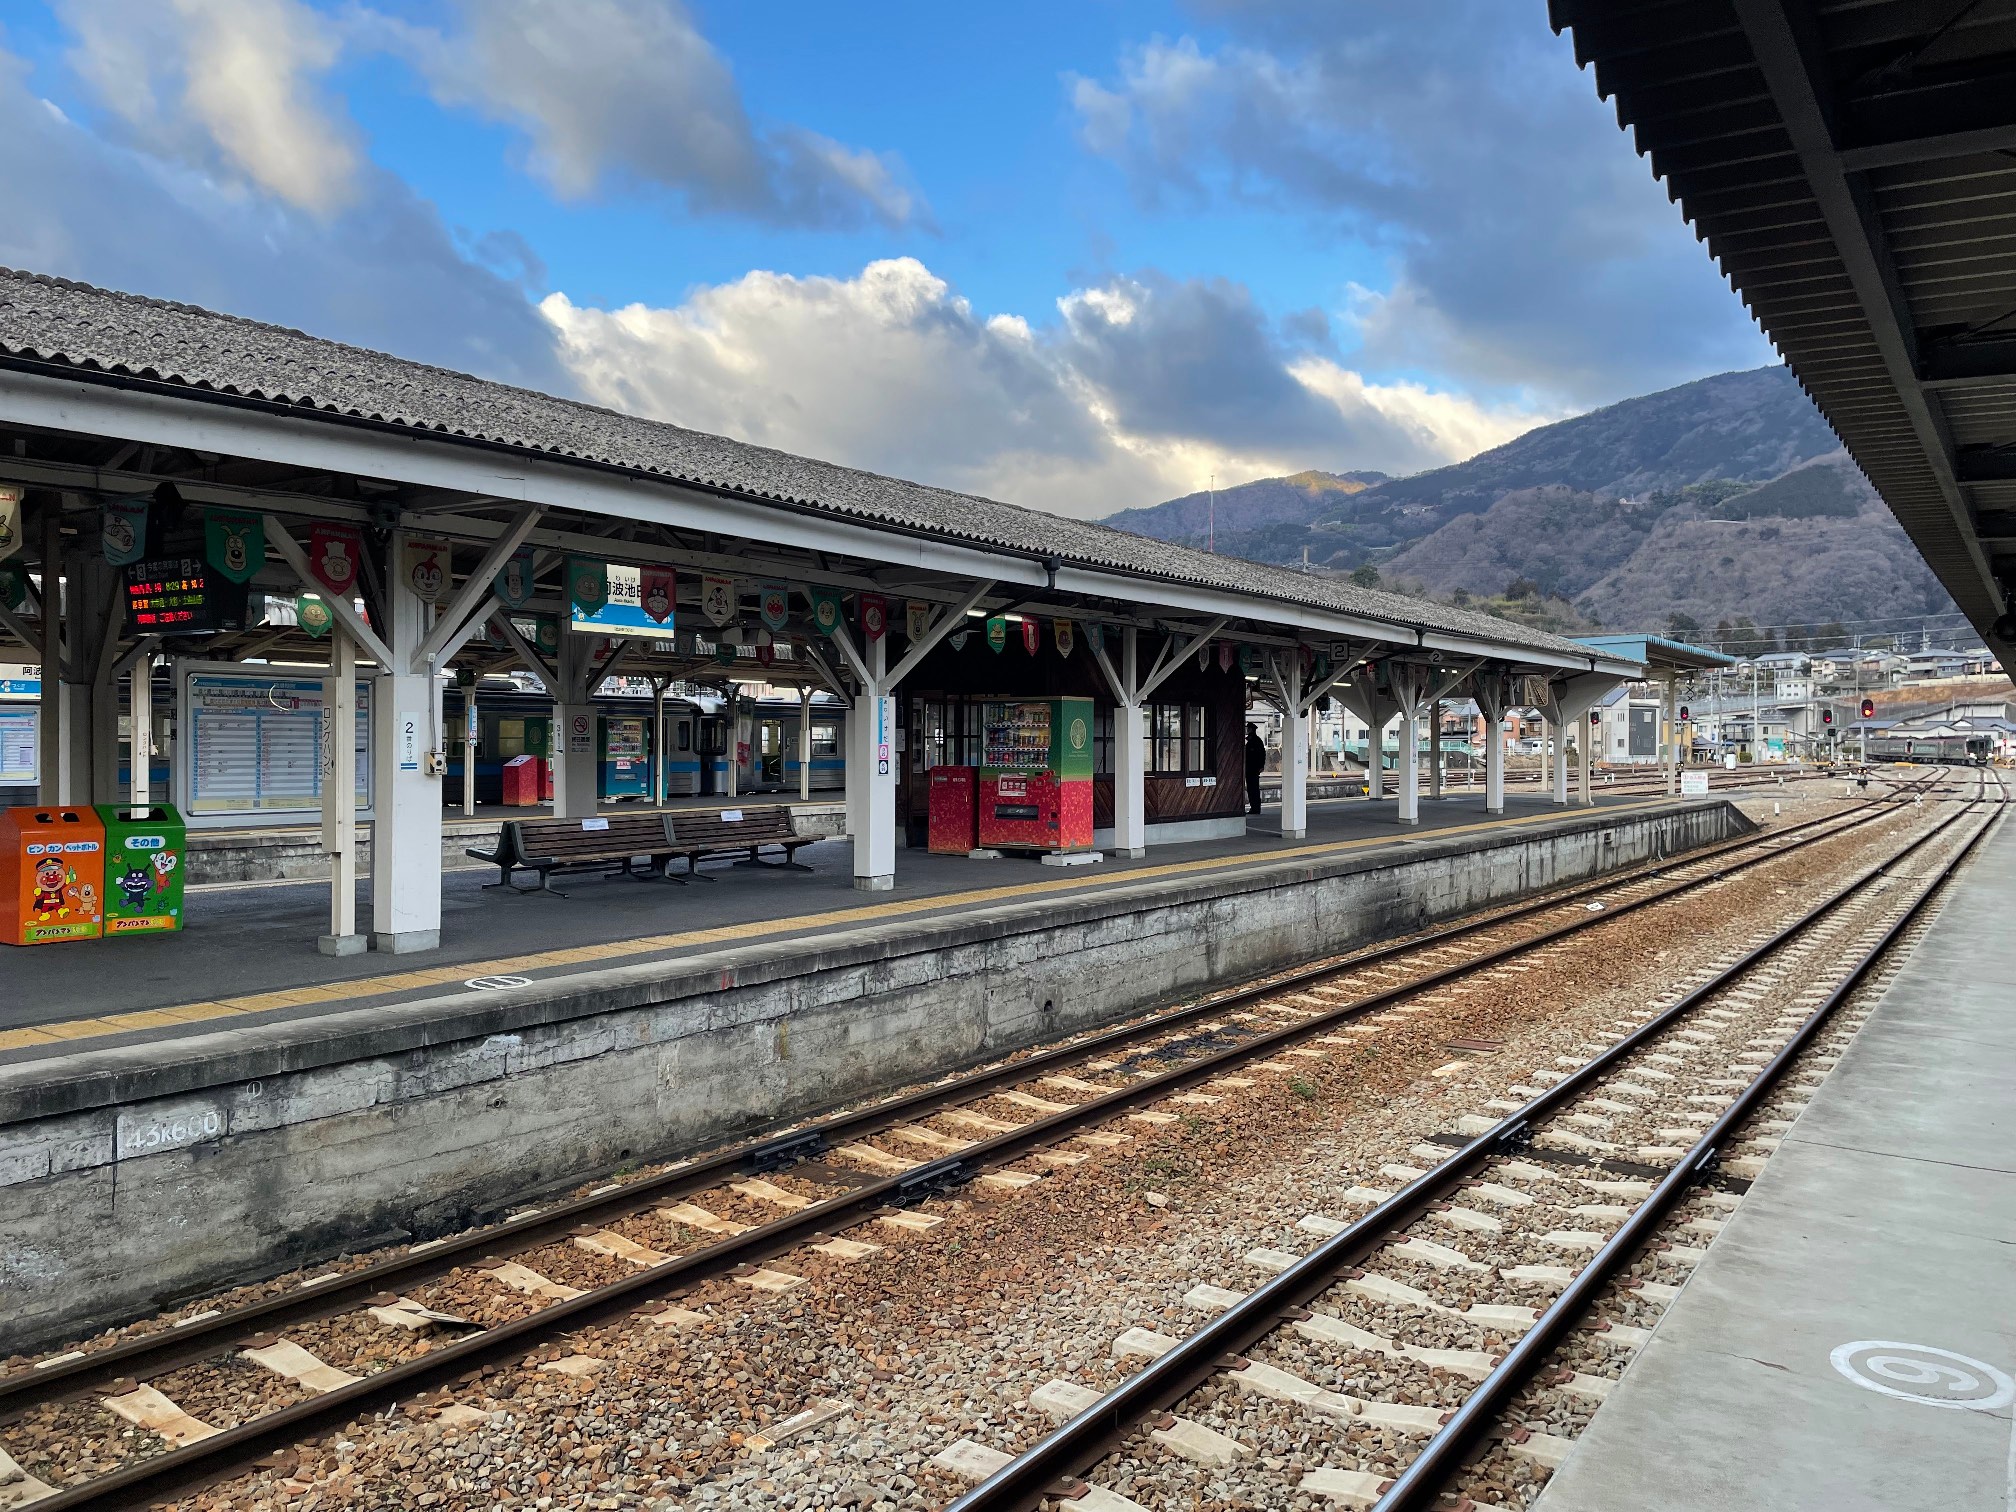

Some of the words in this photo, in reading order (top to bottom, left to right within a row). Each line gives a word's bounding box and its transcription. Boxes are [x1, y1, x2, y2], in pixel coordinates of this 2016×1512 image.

[1334, 644, 1345, 658] 2
[1432, 653, 1440, 663] 2
[686, 683, 694, 693] 4
[323, 707, 331, 779] ロングハンド
[130, 838, 160, 848] その他
